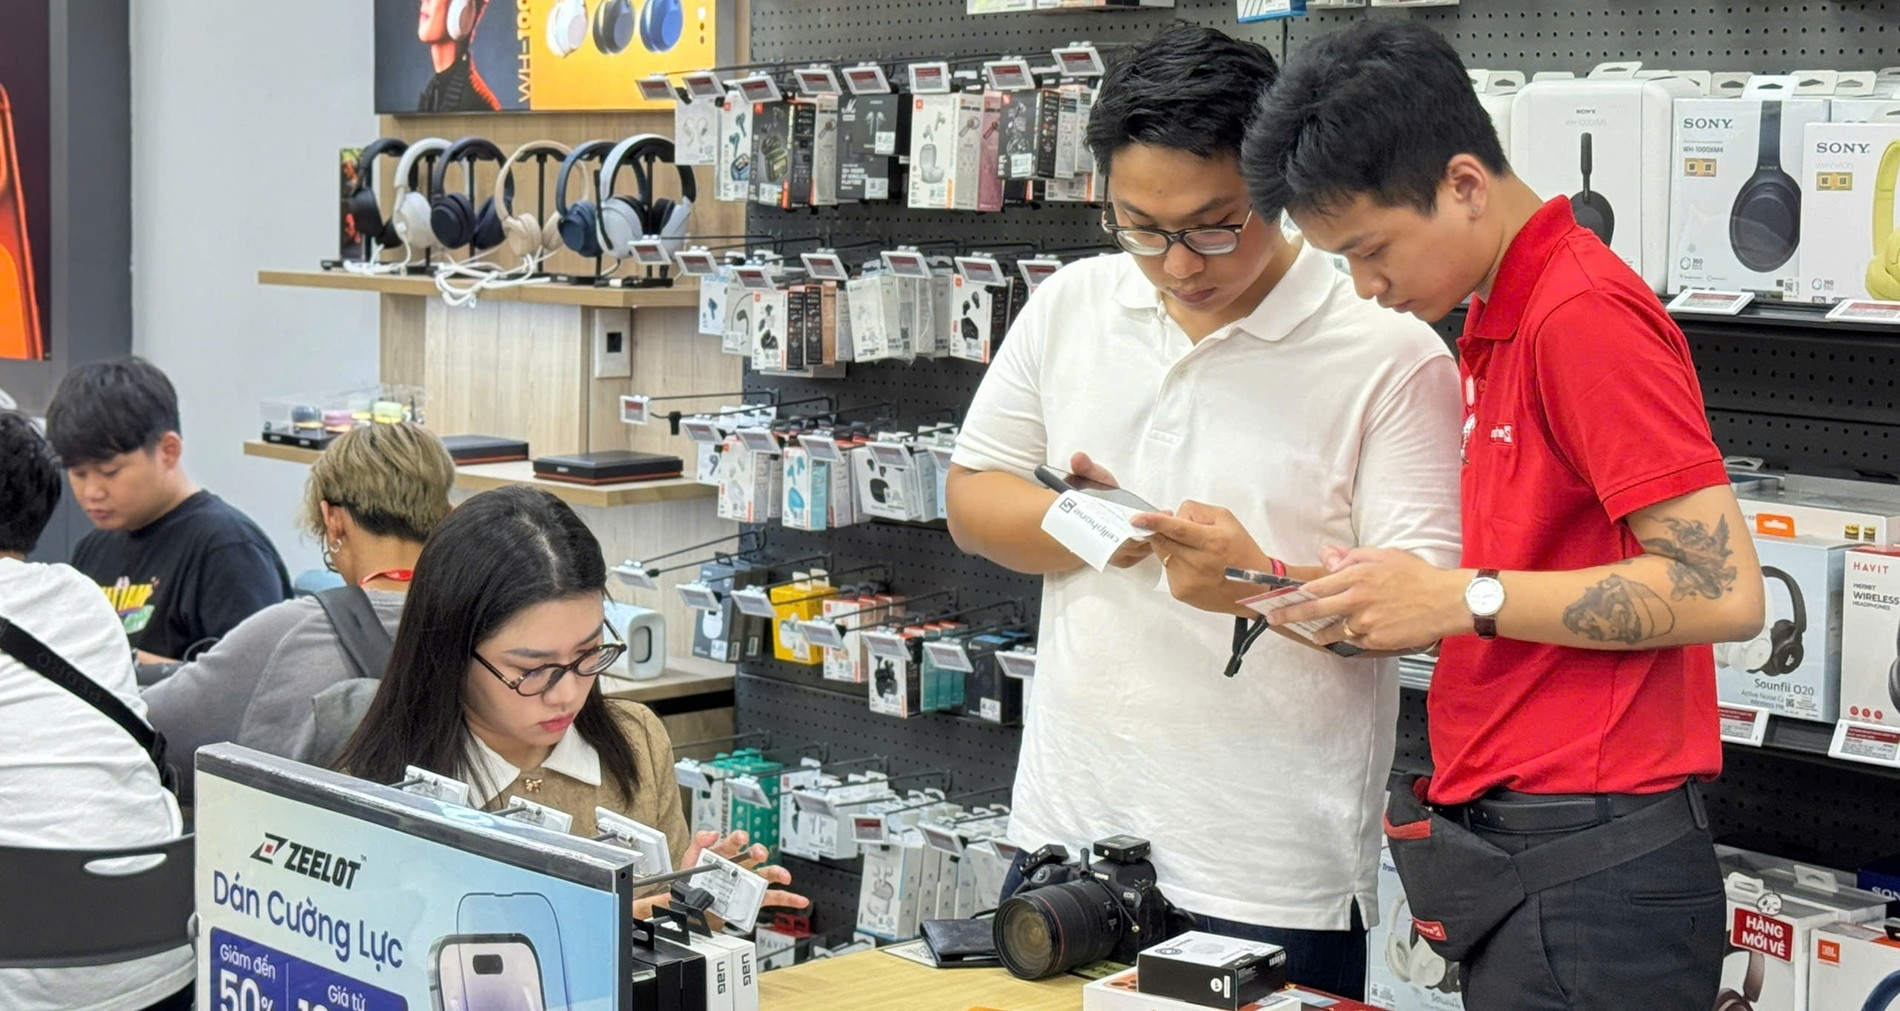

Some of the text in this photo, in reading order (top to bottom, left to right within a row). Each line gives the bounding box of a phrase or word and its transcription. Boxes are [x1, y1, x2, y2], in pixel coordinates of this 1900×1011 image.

[1683, 118, 1733, 129] SONY
[1816, 142, 1870, 154] SONY
[1853, 562, 1889, 574] HAVIT
[1853, 591, 1900, 605] WIRELESS
[284, 841, 361, 890] ZEELOT
[1382, 863, 1398, 873] Tron
[214, 870, 403, 972] Dán Cường Lực
[1745, 916, 1784, 939] HÀNG
[1742, 930, 1786, 957] MỚI VỀ
[220, 944, 276, 980] Giảm đến
[328, 985, 349, 1007] Giá
[352, 993, 366, 1011] từ
